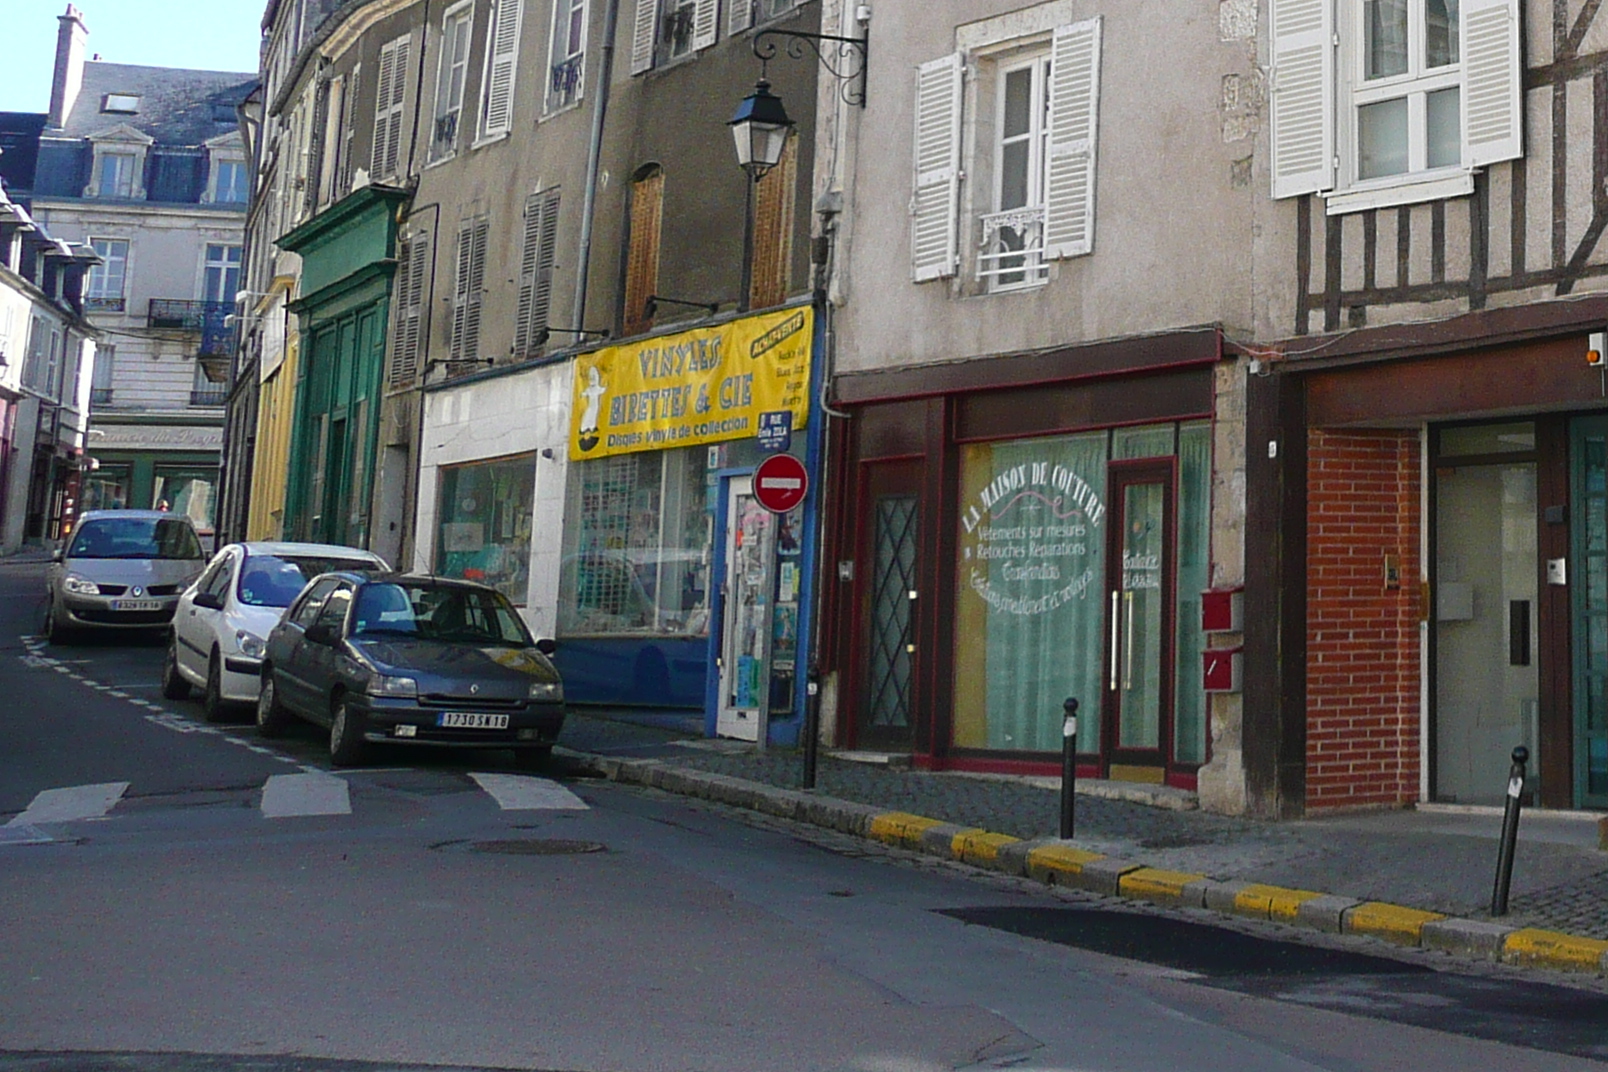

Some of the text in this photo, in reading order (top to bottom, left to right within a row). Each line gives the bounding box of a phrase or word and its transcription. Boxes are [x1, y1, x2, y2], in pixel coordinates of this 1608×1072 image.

[639, 335, 723, 378] VINYLES
[695, 382, 712, 415] &
[719, 373, 754, 409] CIE
[678, 426, 691, 439] de
[693, 416, 749, 435] collection
[962, 461, 1106, 534] LA MAISON DE COUTURE
[1029, 526, 1044, 539] sur
[1046, 524, 1086, 538] mesures
[977, 541, 1026, 560] Retouches
[447, 713, 475, 726] 1730
[494, 715, 508, 727] 18
